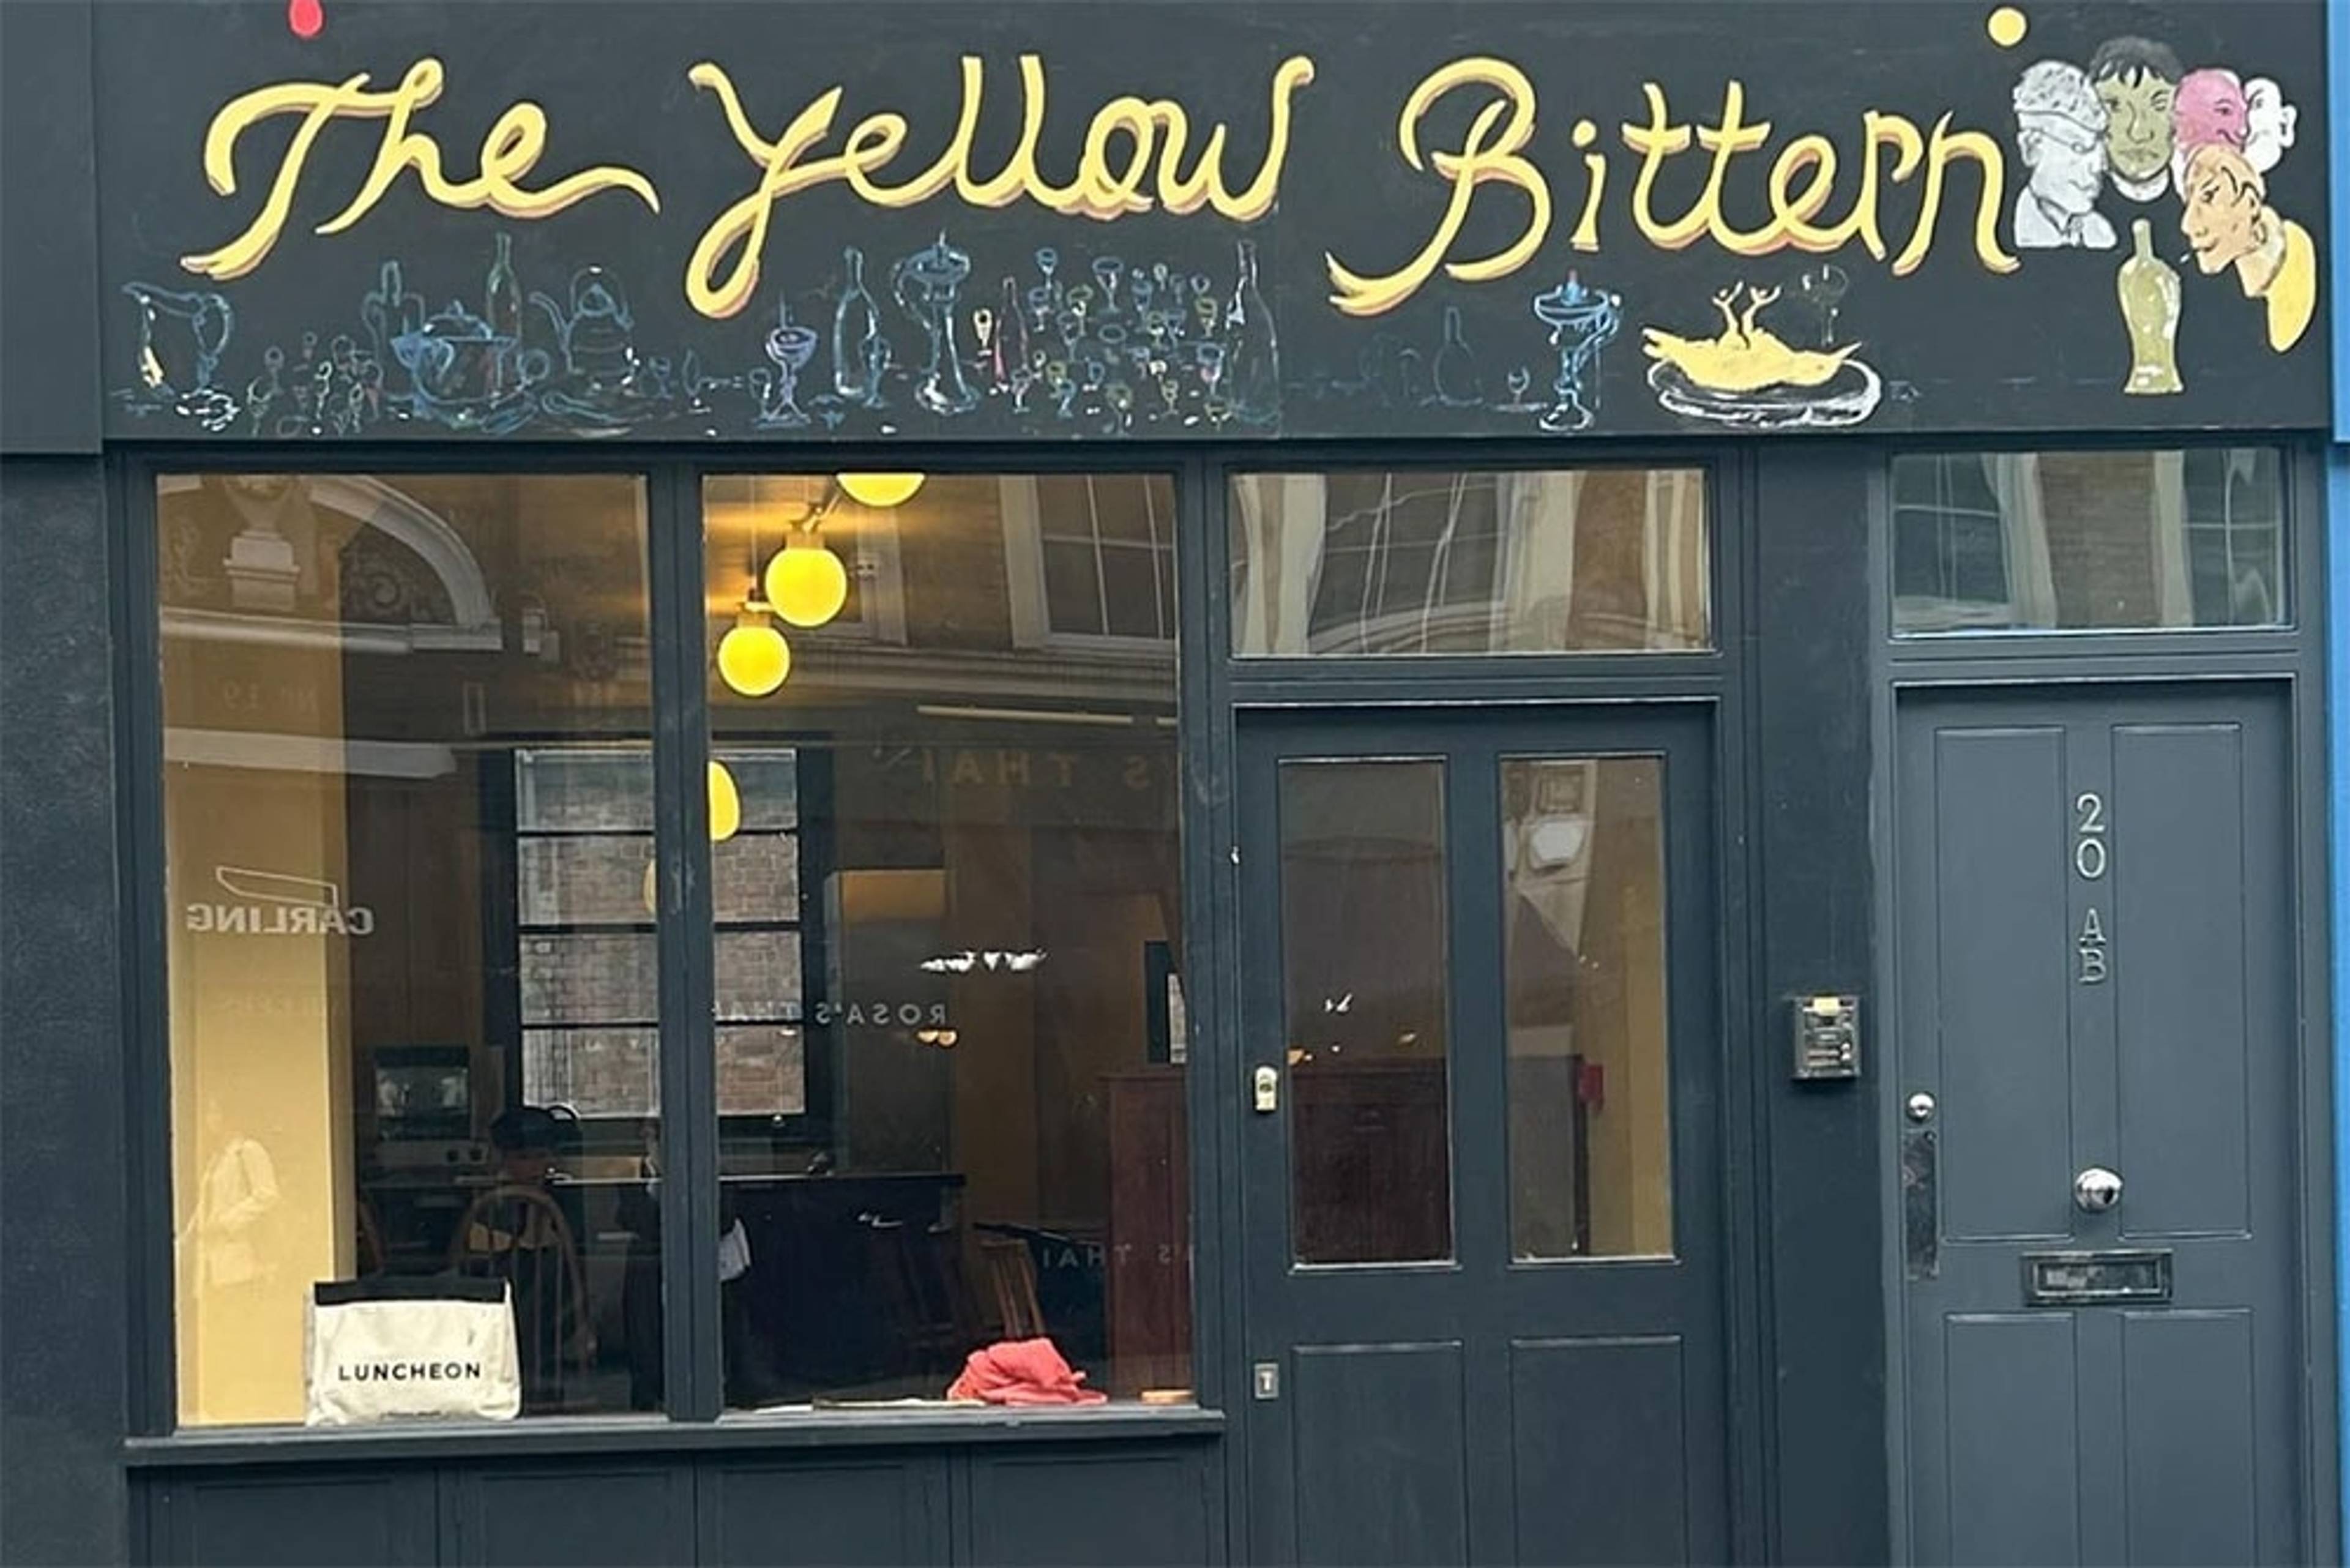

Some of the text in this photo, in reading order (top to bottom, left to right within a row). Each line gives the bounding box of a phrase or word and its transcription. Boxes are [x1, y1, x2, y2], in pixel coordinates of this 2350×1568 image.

[180, 58, 660, 280] The
[1325, 56, 2020, 316] Bittern
[2076, 793, 2106, 983] 20 AB
[337, 1362, 481, 1381] LUNCHEON
